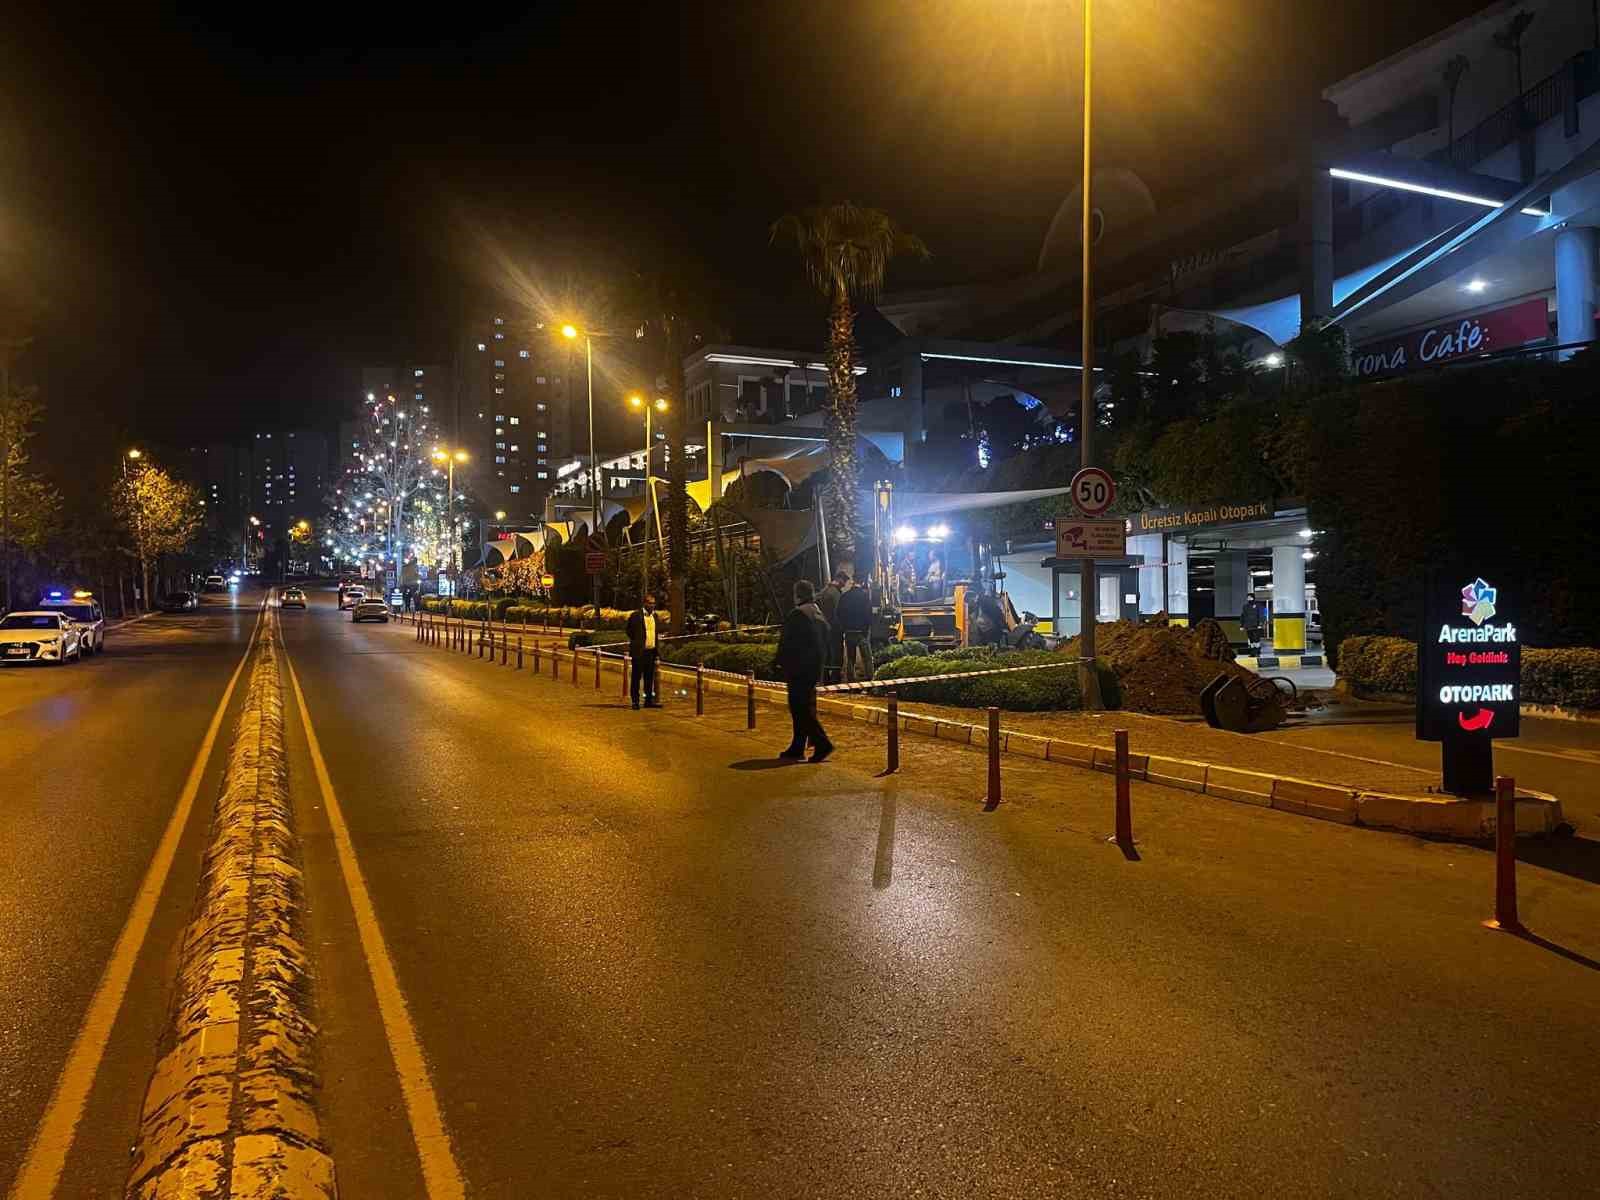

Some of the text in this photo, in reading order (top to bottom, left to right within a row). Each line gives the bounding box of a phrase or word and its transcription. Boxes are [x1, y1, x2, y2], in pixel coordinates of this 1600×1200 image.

[1354, 346, 1407, 377] rona
[1080, 482, 1106, 502] 50
[1141, 502, 1267, 530] Ücretsiz Kapalı Otopark
[1438, 623, 1516, 643] ArenaPark
[1440, 684, 1514, 703] OTOPARK
